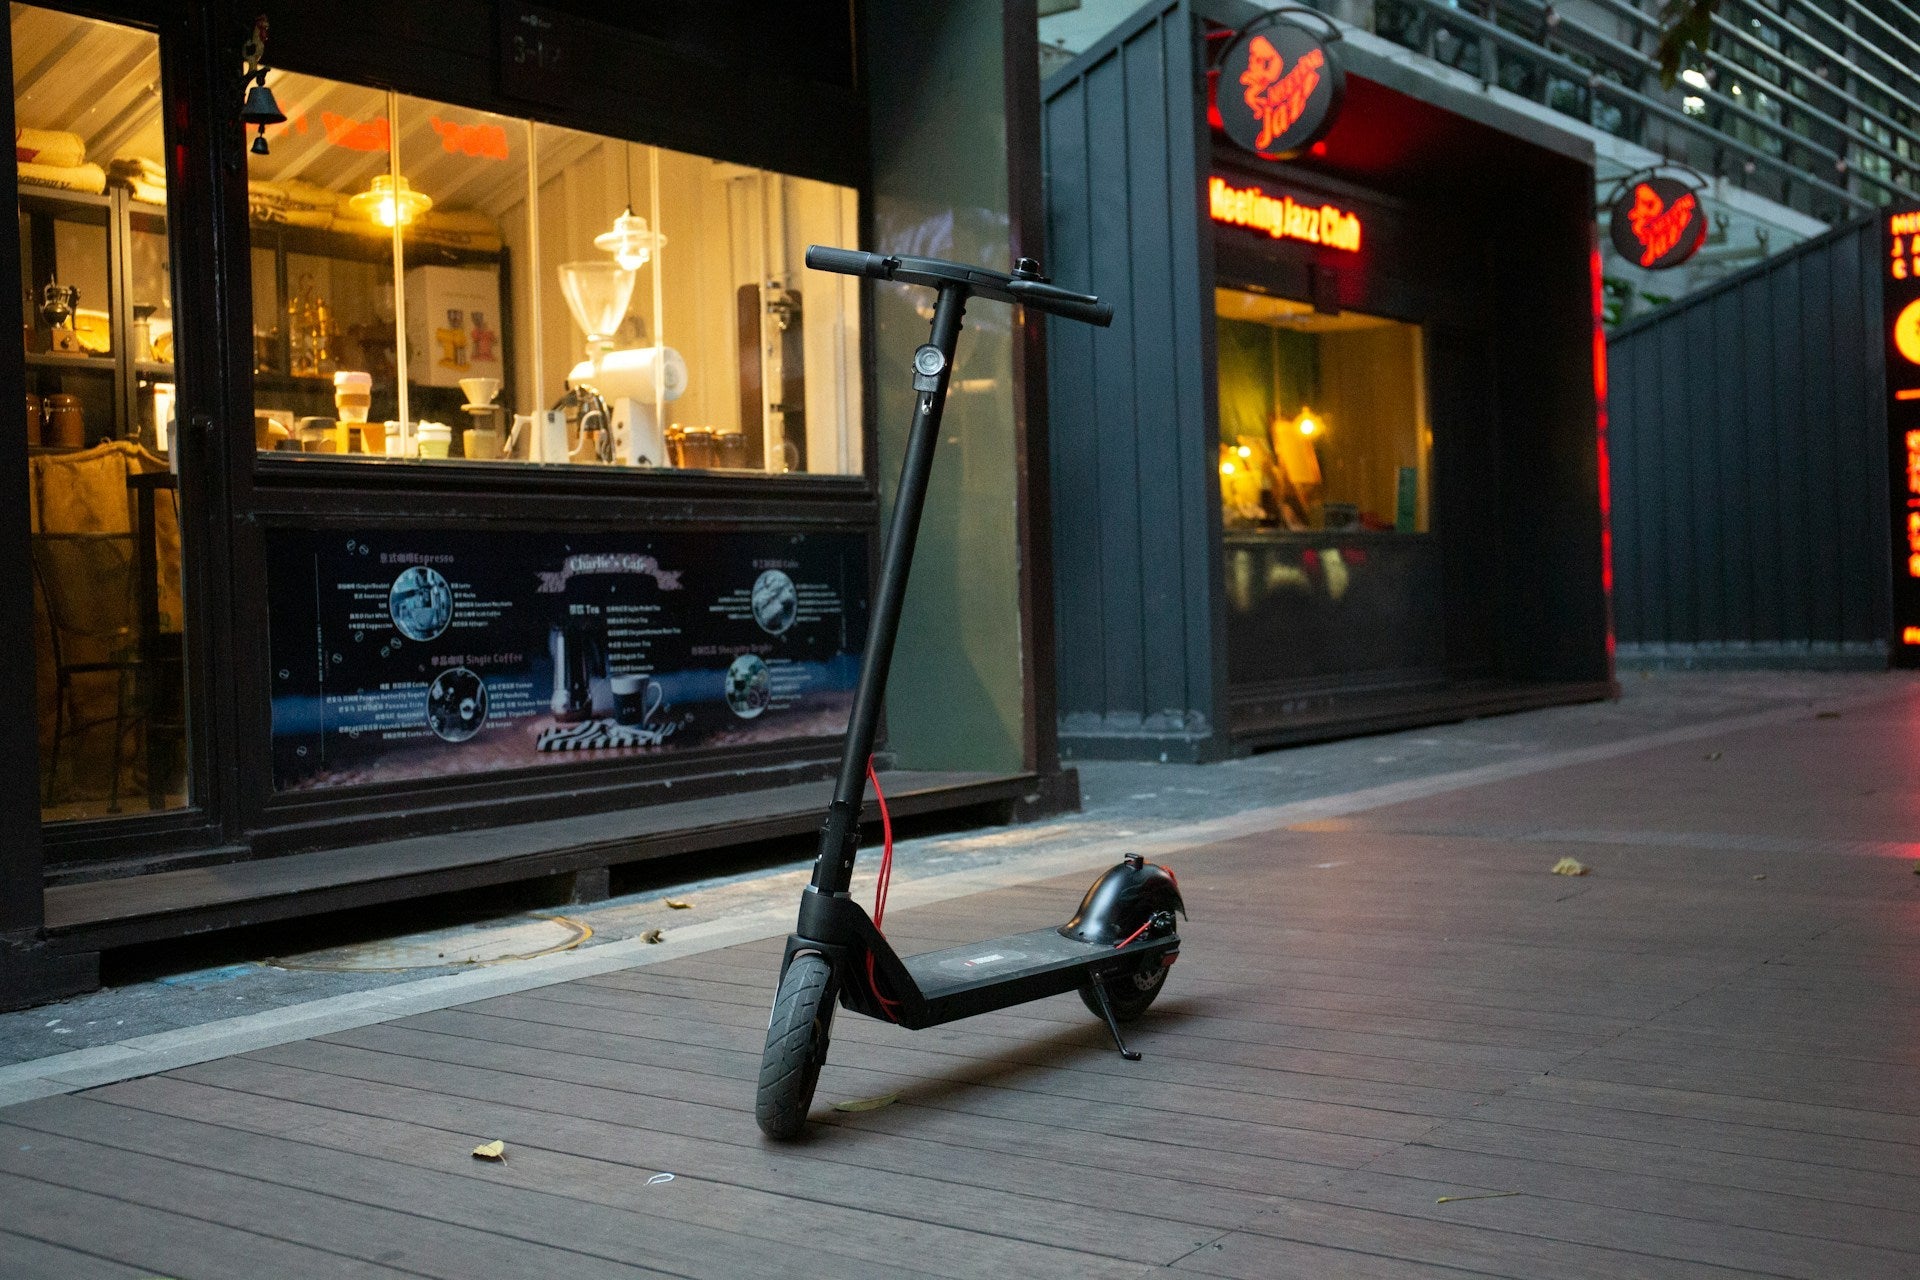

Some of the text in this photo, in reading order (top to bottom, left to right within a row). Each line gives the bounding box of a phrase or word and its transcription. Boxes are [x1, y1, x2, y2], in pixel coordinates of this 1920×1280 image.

[1208, 176, 1362, 253] Meeting Jazz Club
[466, 654, 491, 667] Single
[493, 652, 524, 664] Coffee
